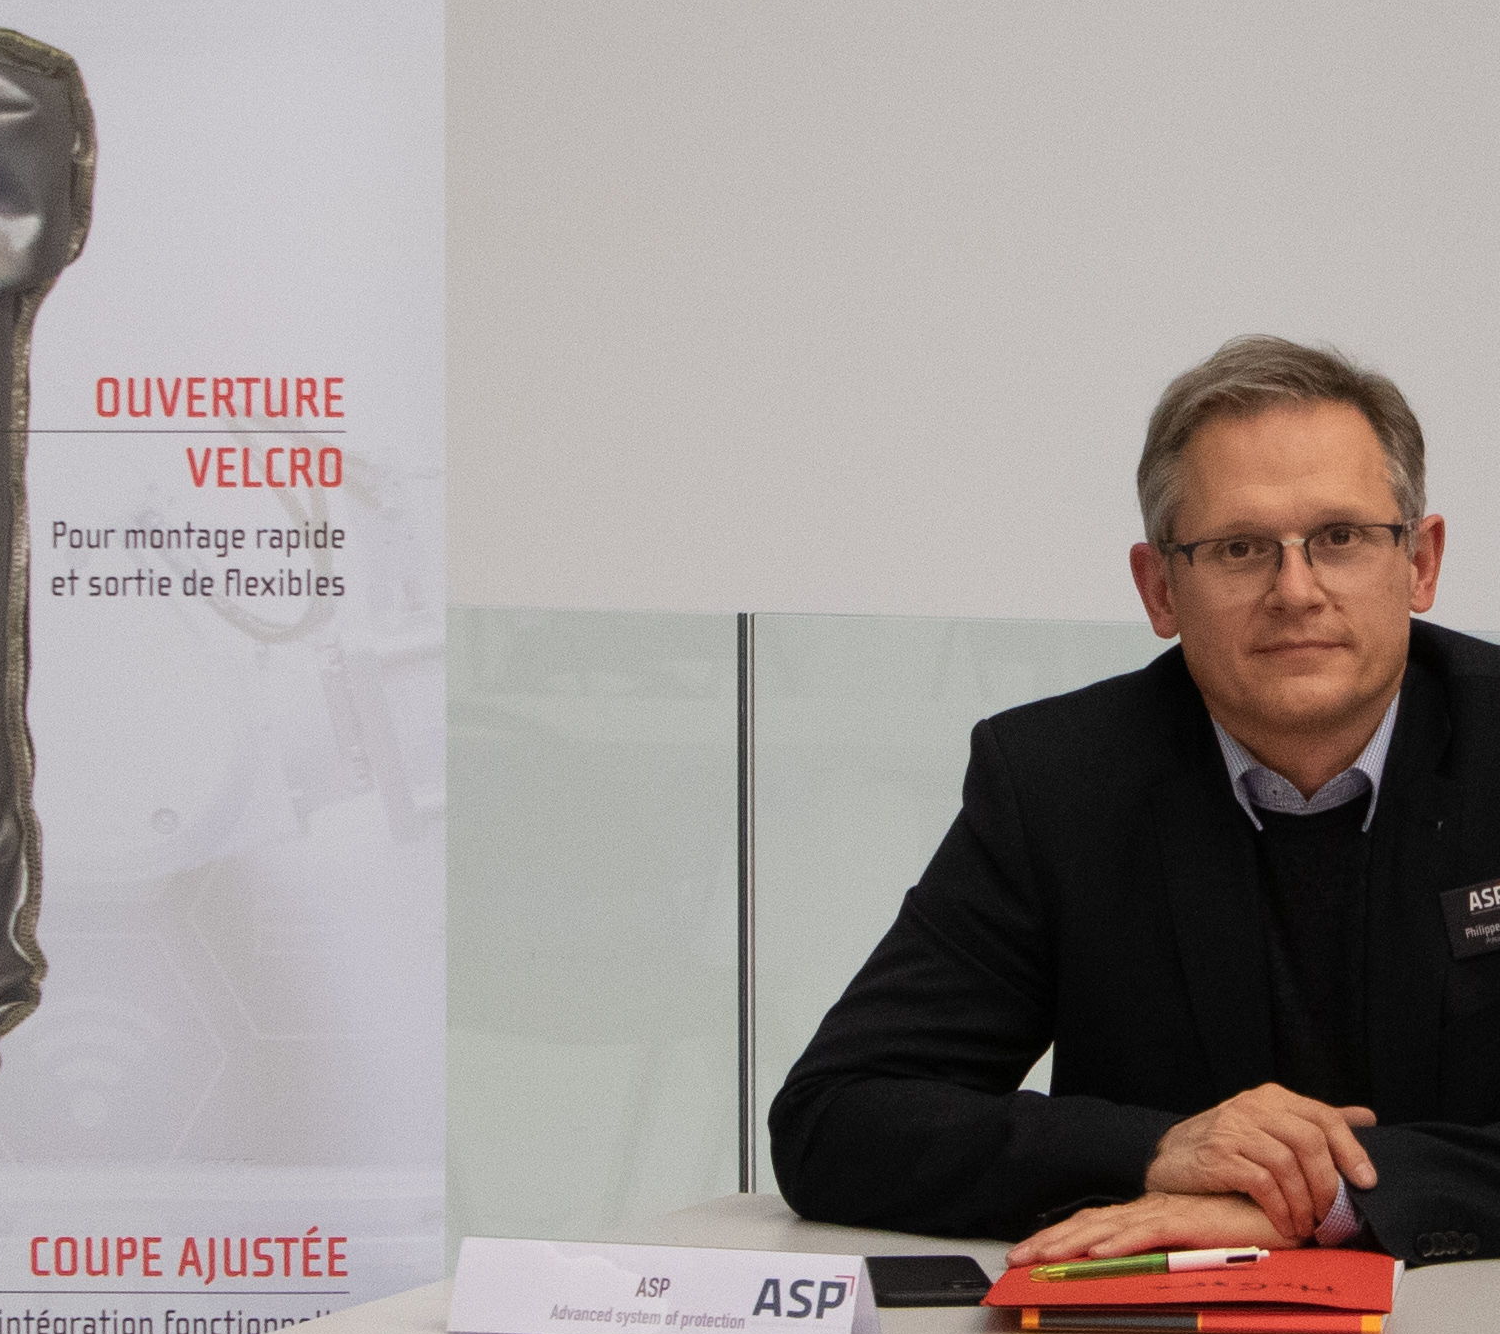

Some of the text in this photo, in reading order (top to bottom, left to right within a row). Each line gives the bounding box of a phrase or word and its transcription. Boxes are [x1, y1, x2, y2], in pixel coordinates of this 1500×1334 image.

[96, 376, 346, 418] OUVERTURE
[186, 447, 344, 488] VELCRO
[52, 521, 347, 558] Pour montage rapide
[51, 569, 347, 597] et sortie de flexibles
[1465, 923, 1500, 940] Philippe
[30, 1226, 350, 1286] COUPE AJUSTÉE
[635, 1276, 671, 1299] ASP
[752, 1278, 848, 1320] ASP
[550, 1304, 613, 1323] Advanced
[614, 1309, 662, 1328] system
[664, 1310, 679, 1326] of
[680, 1311, 746, 1331] protection
